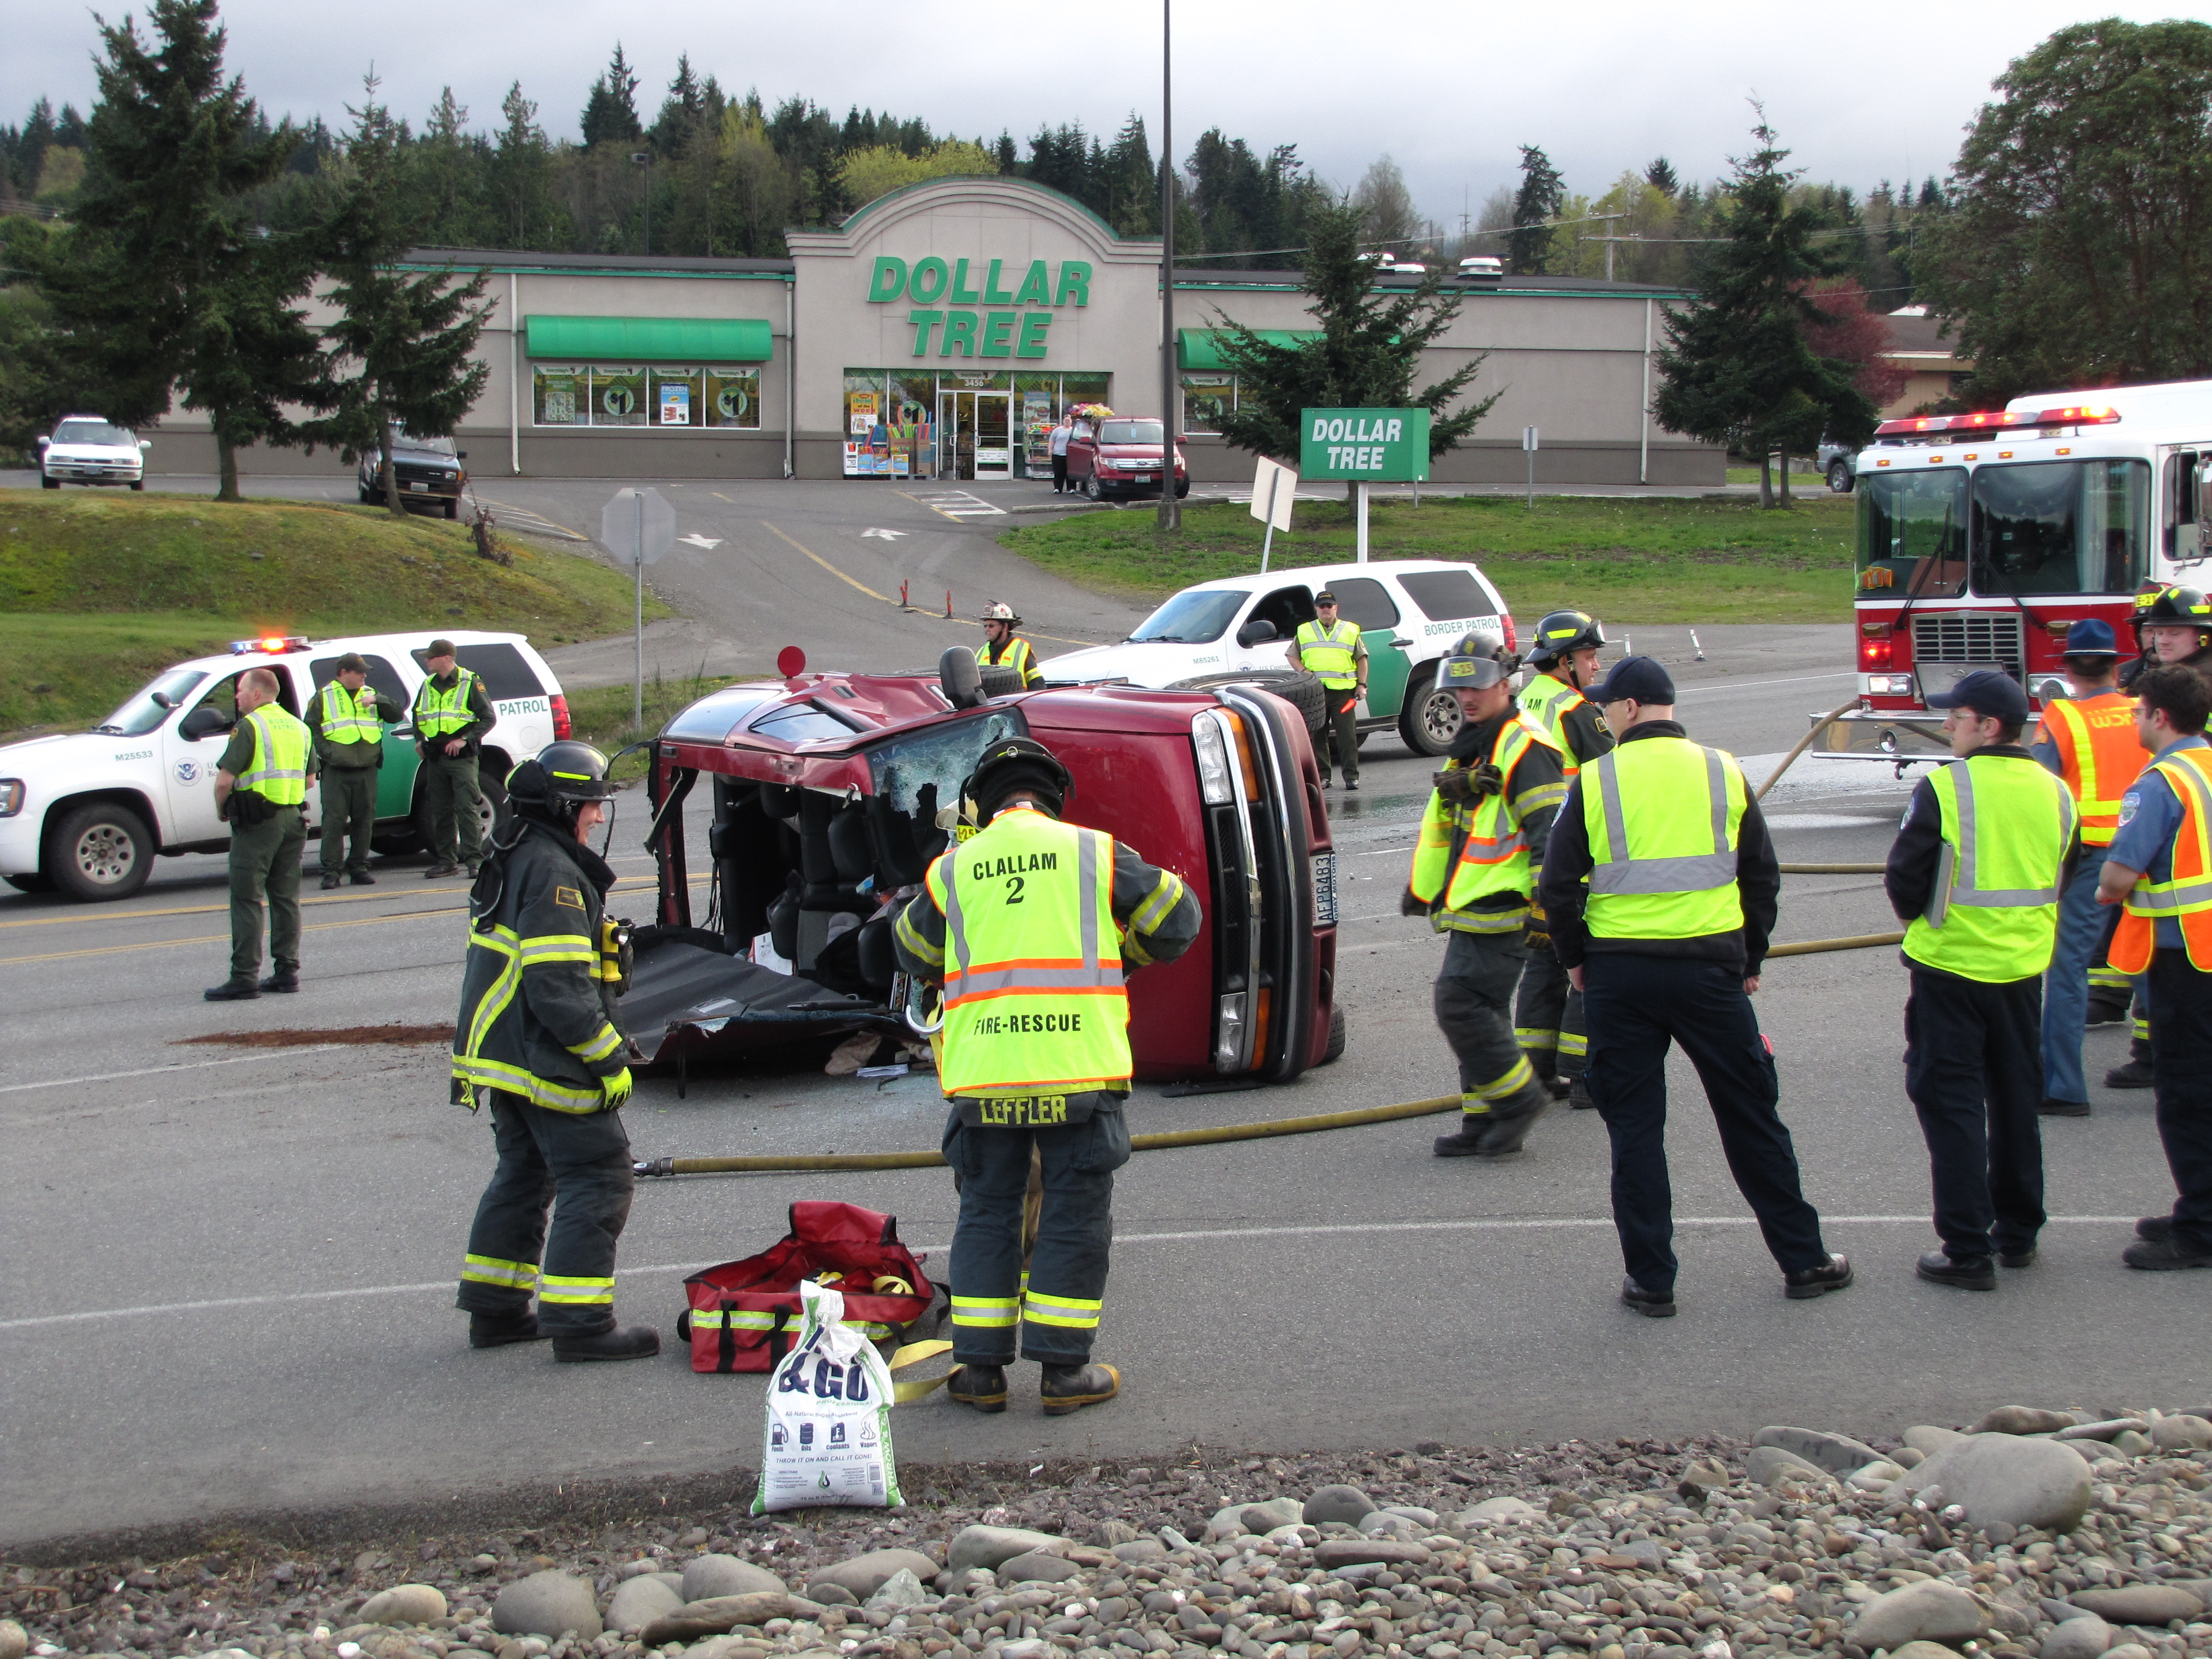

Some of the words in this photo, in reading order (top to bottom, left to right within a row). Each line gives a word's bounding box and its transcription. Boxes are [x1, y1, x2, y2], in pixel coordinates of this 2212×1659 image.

[867, 256, 1093, 306] DOLLAR
[907, 310, 1053, 358] TREE
[1312, 419, 1402, 442] DOLLAR
[1327, 446, 1385, 470] TREE
[1425, 622, 1463, 636] BORDER
[1466, 618, 1500, 632] PATROL
[1193, 656, 1220, 664] M85261
[499, 700, 548, 716] PATROL
[115, 750, 153, 762] M25533
[973, 853, 1057, 880] CLALLAM
[1006, 877, 1025, 905] 2
[1316, 857, 1333, 921] AFP6483
[974, 1014, 1081, 1035] FIRE-RESCUE
[979, 1095, 1067, 1124] LEFFLER
[884, 1441, 895, 1487] THROW
